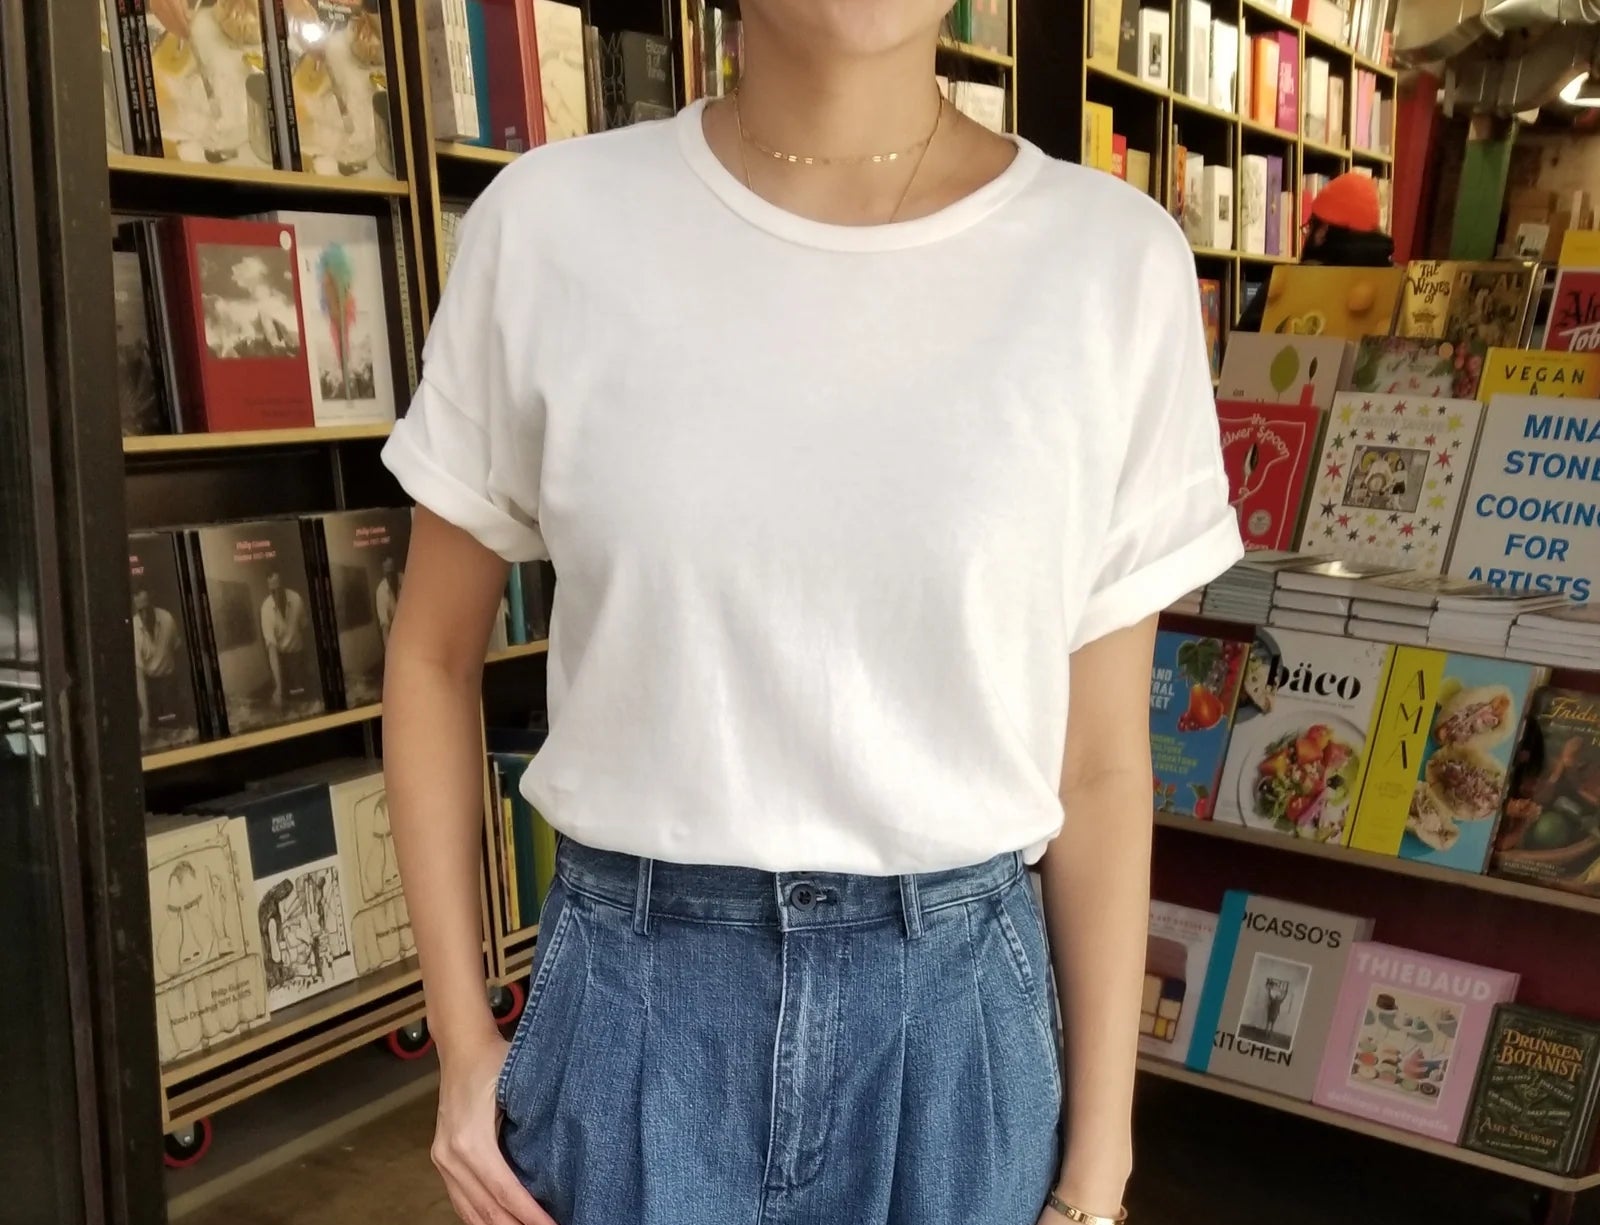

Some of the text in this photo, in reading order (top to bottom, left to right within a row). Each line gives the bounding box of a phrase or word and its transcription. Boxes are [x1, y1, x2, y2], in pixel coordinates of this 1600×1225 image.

[1420, 263, 1440, 279] THE
[1504, 364, 1585, 386] VEGAN
[1523, 413, 1600, 443] MINA
[1503, 450, 1600, 482] STONE
[1476, 493, 1600, 528] COOKIN
[1505, 533, 1570, 562] FOR
[1468, 566, 1591, 602] ARTISTS
[1266, 655, 1361, 701] bäco
[1356, 952, 1492, 1001] THIEBAUD
[1503, 1028, 1584, 1061] DRUNKEN
[1497, 1045, 1582, 1082] BOTANIST
